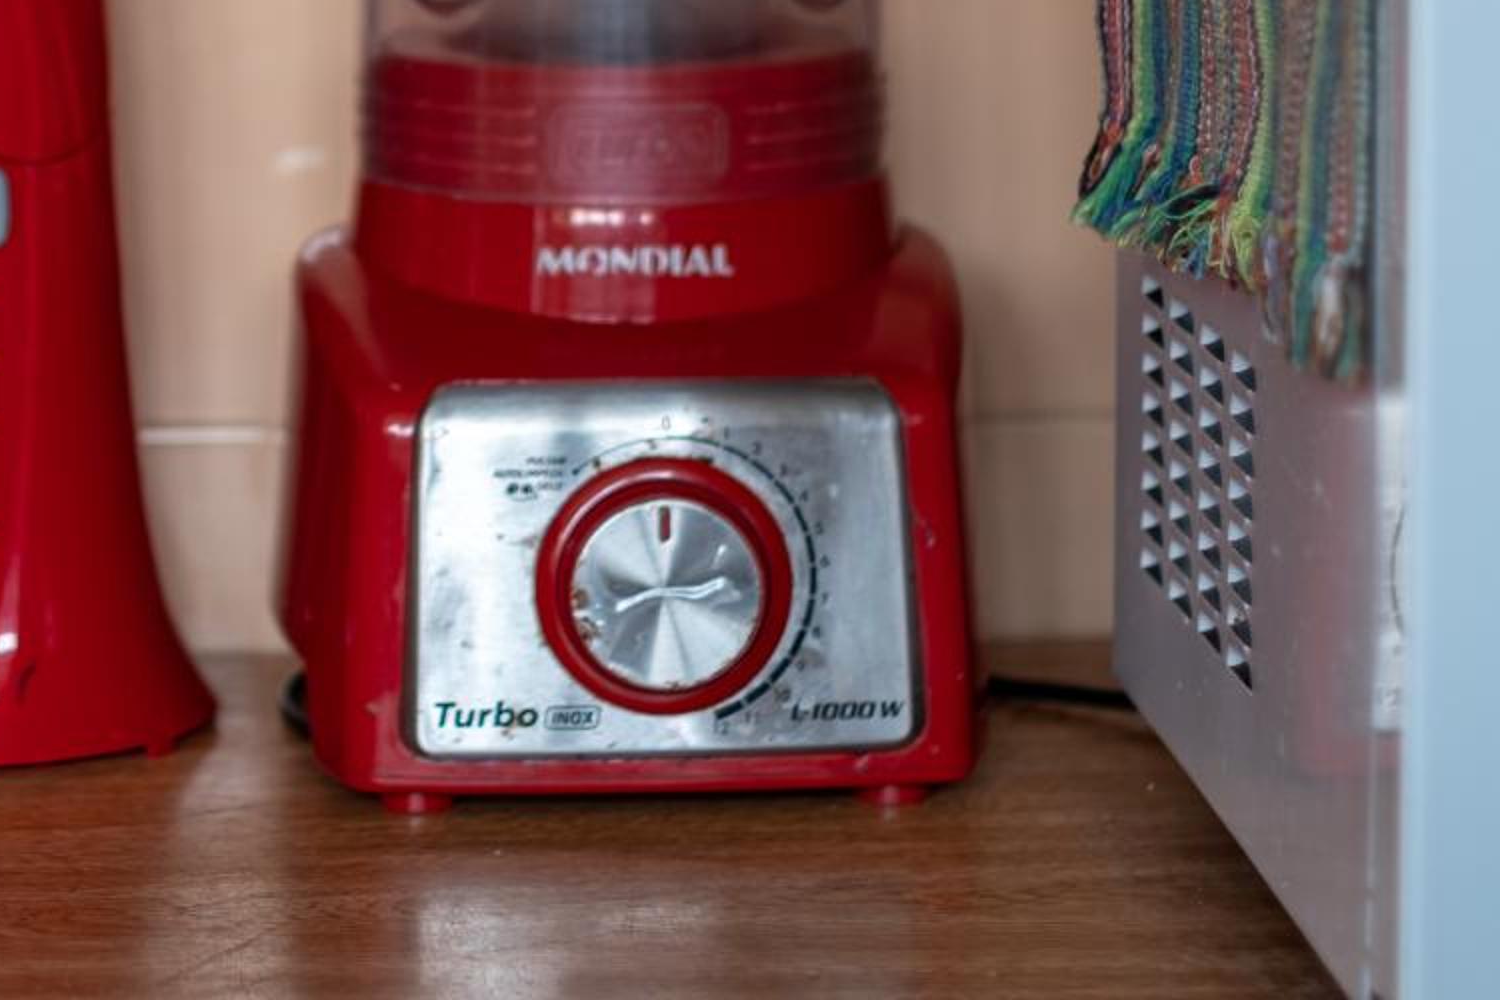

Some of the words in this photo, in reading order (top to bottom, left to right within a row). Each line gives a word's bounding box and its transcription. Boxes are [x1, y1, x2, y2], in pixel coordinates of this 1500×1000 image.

[538, 244, 734, 277] MONDIAL
[434, 701, 539, 728] Turbo
[551, 710, 594, 726] INOX
